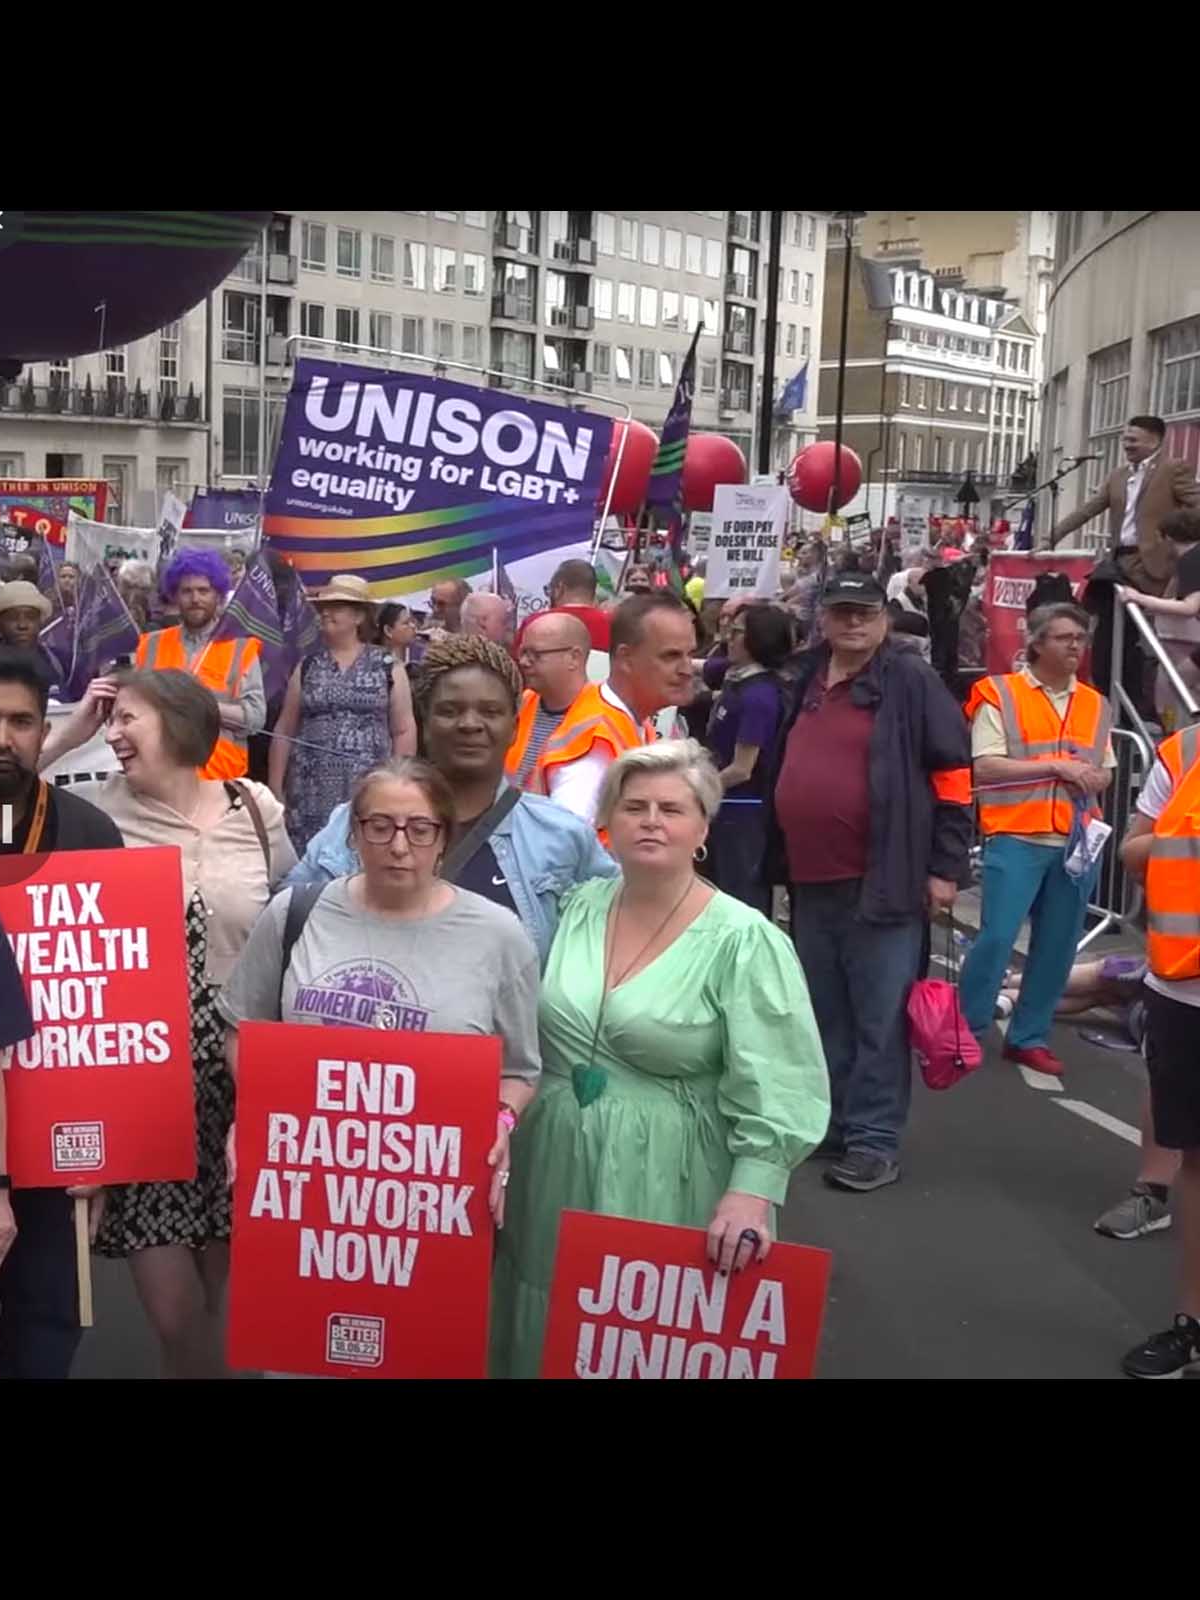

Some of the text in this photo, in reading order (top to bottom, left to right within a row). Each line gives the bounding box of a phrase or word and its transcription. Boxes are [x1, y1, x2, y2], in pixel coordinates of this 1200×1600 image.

[305, 376, 592, 481] UNISON
[36, 482, 49, 492] IN
[52, 482, 97, 492] UNISON
[291, 467, 416, 511] equality
[298, 436, 580, 505] working for LGBT+
[723, 521, 773, 533] IF OUR PAY
[756, 535, 778, 547] RISE
[726, 549, 763, 561] WE WILL
[26, 883, 104, 927] TAX
[30, 976, 108, 1021] NOT
[294, 988, 355, 1019] WOMEN
[316, 1059, 416, 1116] END
[56, 1134, 99, 1148] BETTER
[267, 1112, 461, 1177] RACISM
[249, 1168, 475, 1237] AT WORK
[299, 1229, 419, 1288] NOW
[577, 1255, 786, 1345] JOIN A
[332, 1325, 380, 1344] BETTER
